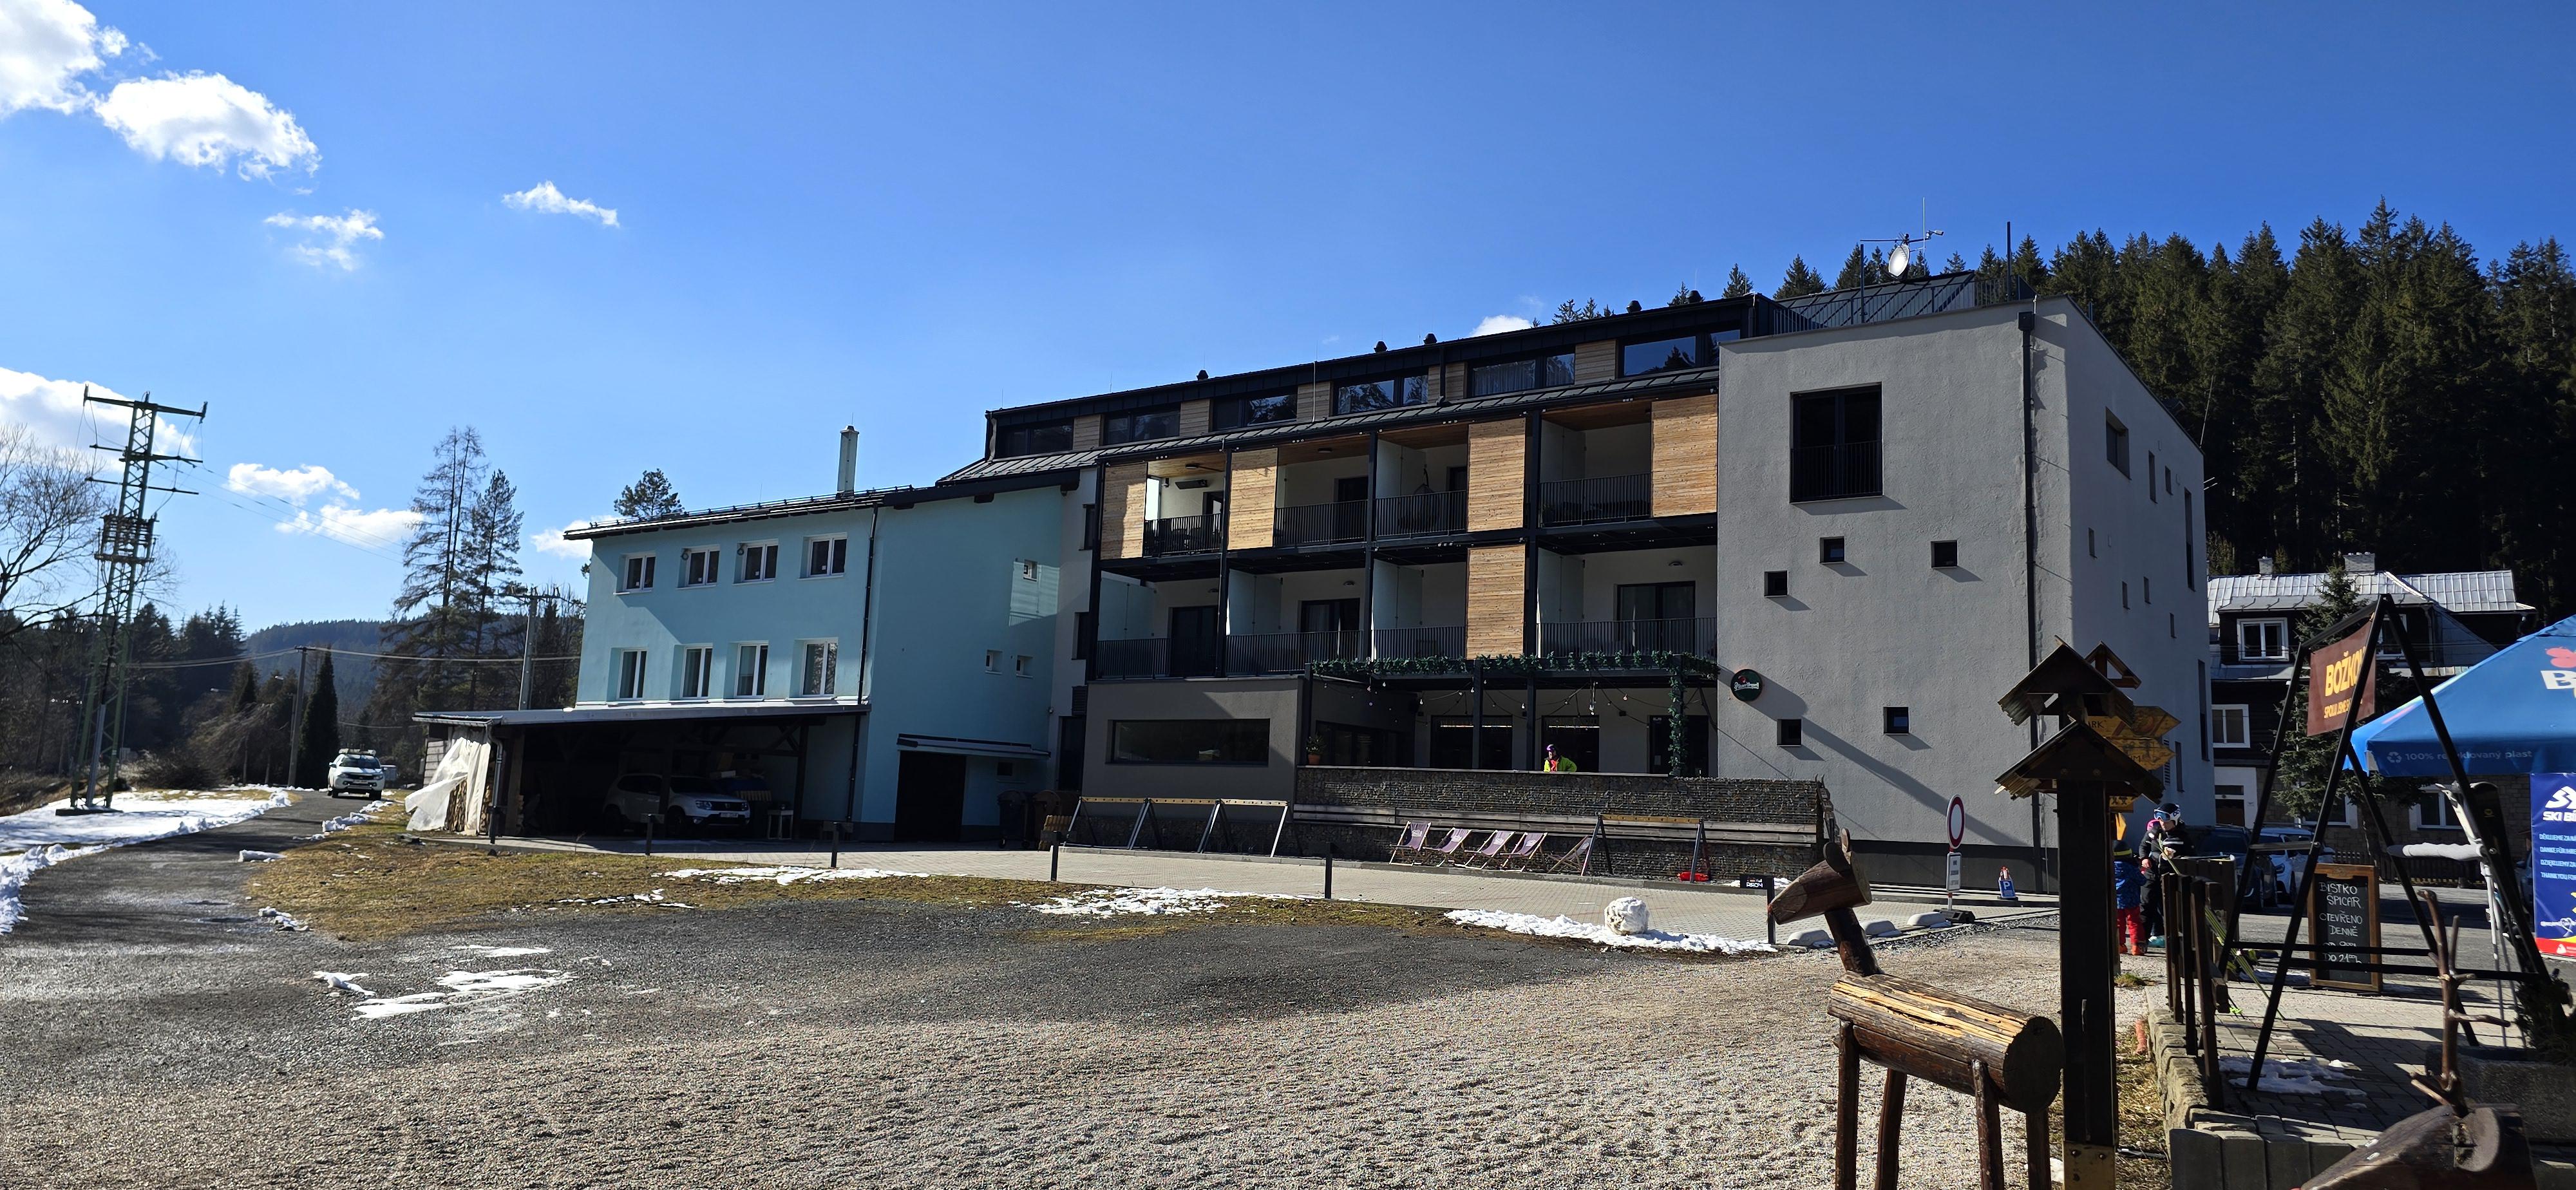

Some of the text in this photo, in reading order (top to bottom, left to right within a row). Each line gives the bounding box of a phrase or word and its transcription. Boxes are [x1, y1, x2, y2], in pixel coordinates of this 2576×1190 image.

[2437, 751, 2501, 760] reklovaný
[2505, 750, 2533, 759] plast
[2543, 811, 2562, 821] SKI
[2003, 881, 2011, 890] P
[2319, 882, 2358, 894] BISTRO
[2326, 892, 2362, 909] ŠPICAR
[2319, 910, 2363, 925] OTEVŘENO
[2328, 925, 2358, 937] DENNĚ
